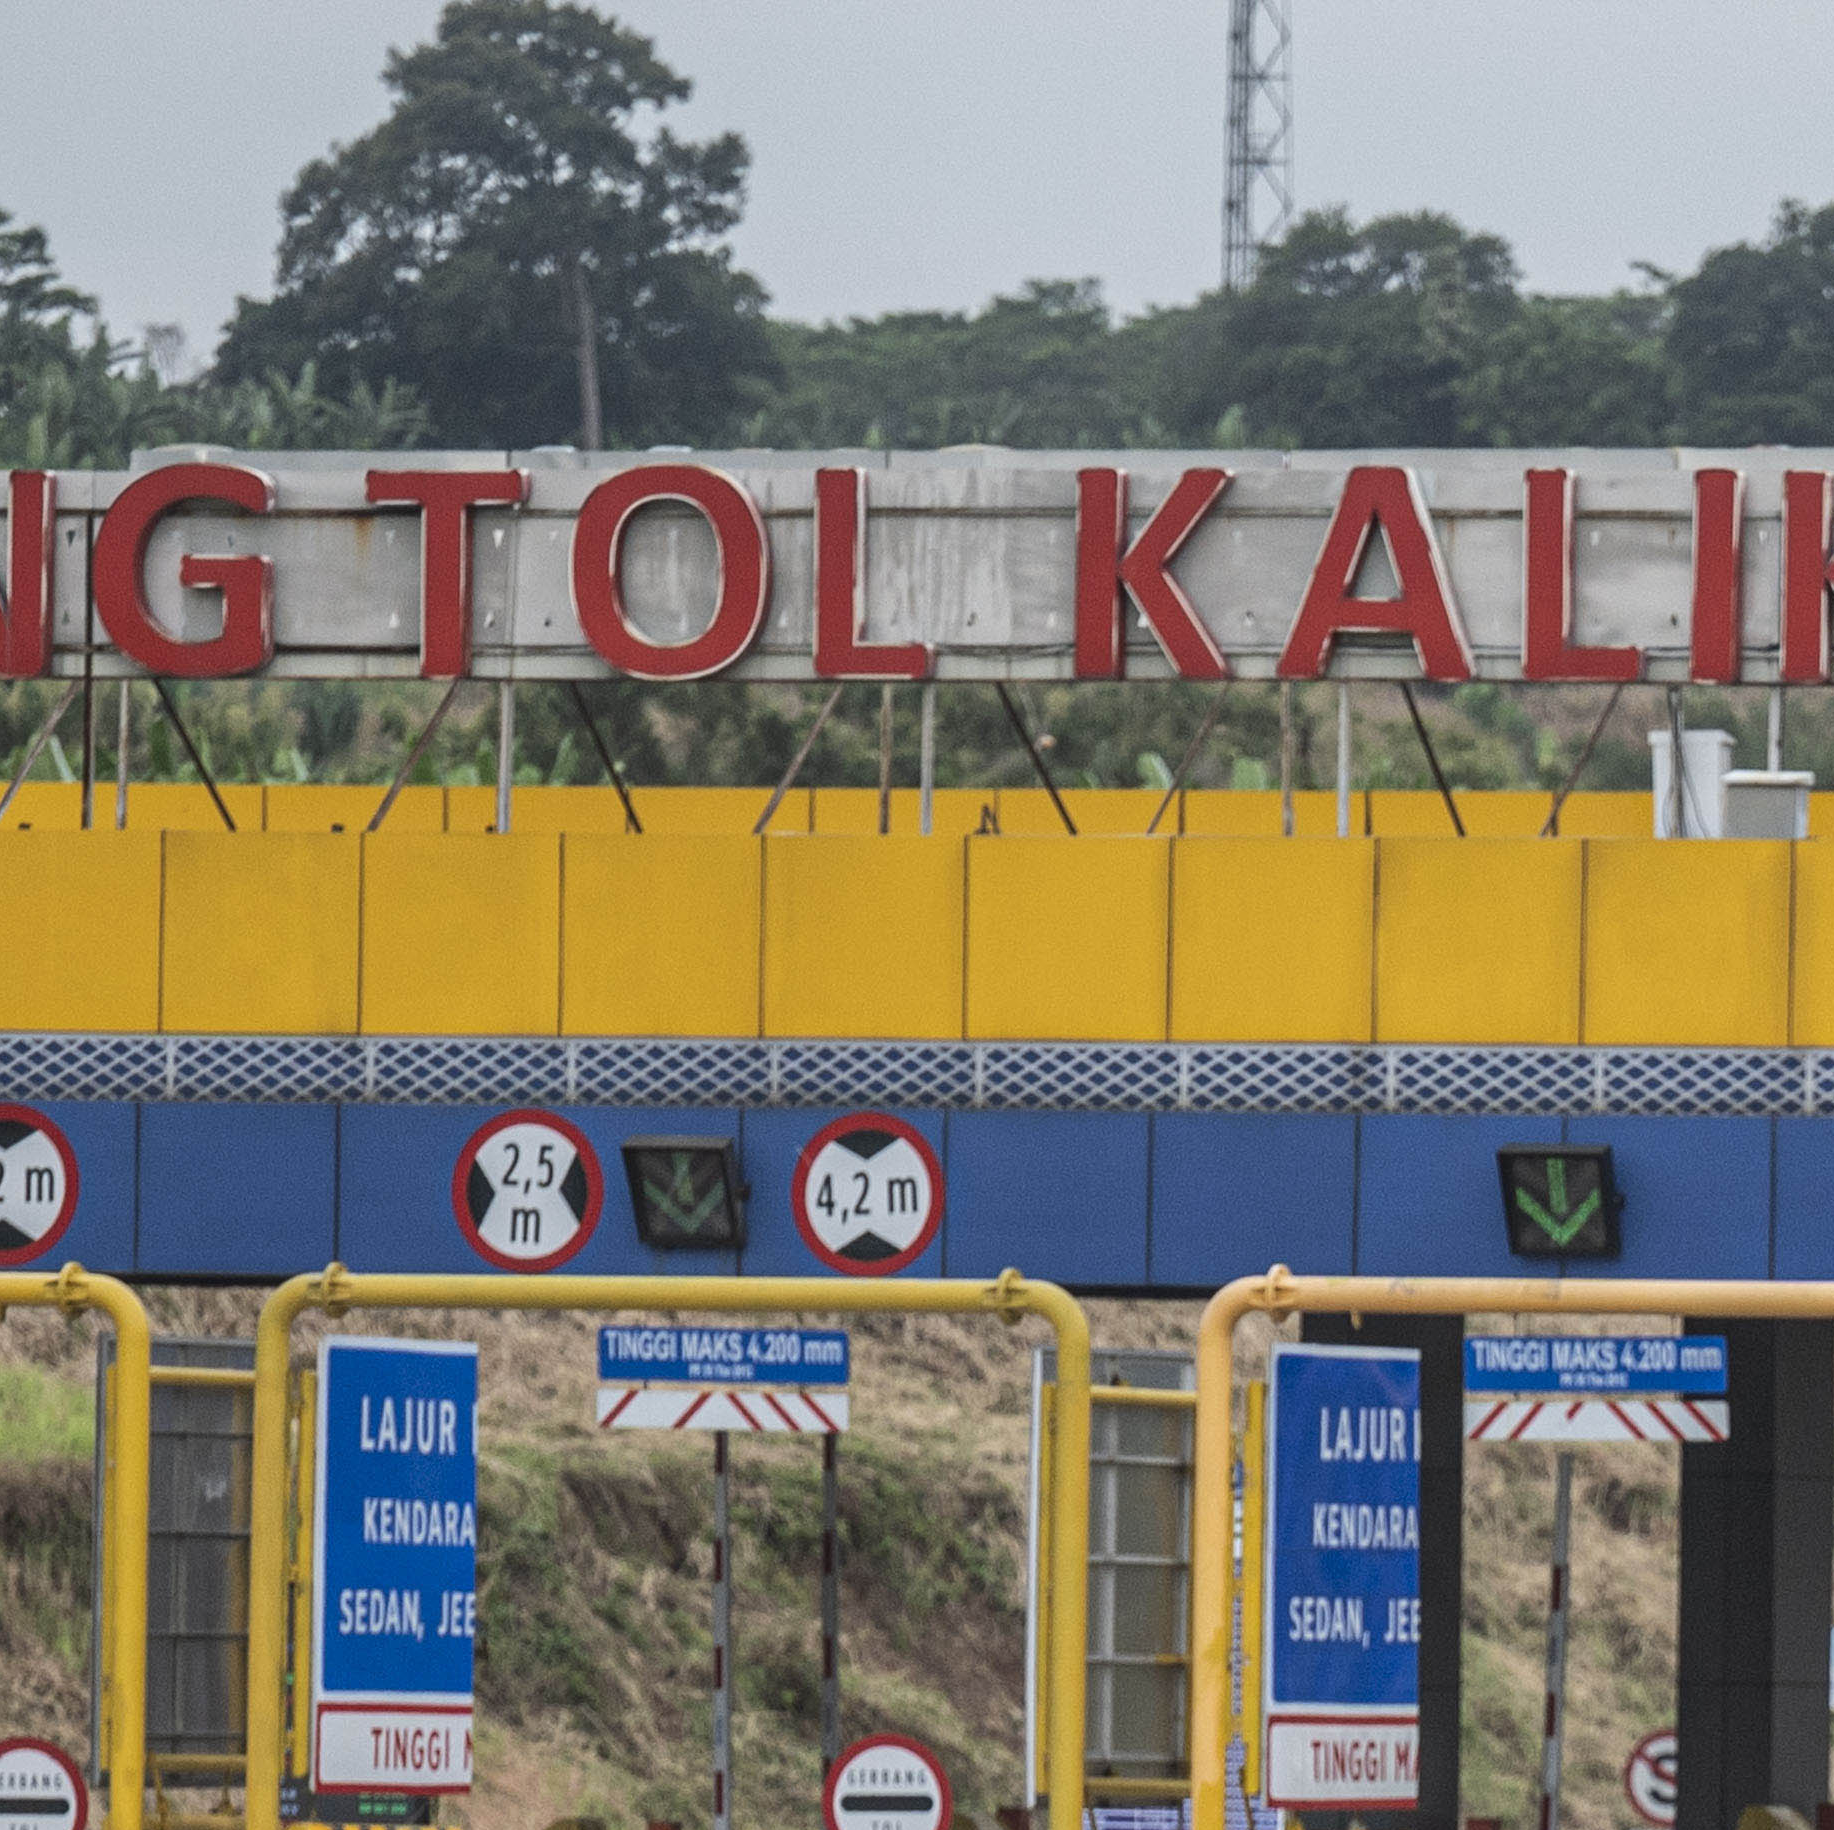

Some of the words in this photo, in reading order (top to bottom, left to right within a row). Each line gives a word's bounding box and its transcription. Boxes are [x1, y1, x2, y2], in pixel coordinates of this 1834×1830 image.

[367, 463, 936, 680] TOL
[24, 1165, 56, 1203] m
[501, 1142, 556, 1196] 2,5
[815, 1172, 871, 1223] 4,2
[886, 1175, 919, 1215] m
[510, 1205, 542, 1244] m
[605, 1329, 678, 1361] TINGGI
[681, 1331, 741, 1362] MAKS
[746, 1333, 801, 1364] 4.200
[803, 1339, 844, 1365] mm
[1471, 1339, 1548, 1371] TINGGI
[1551, 1340, 1617, 1371] MAKS
[1620, 1341, 1677, 1371] 4.200
[1680, 1346, 1723, 1371] mm
[360, 1396, 457, 1456] LAJUR
[1319, 1406, 1408, 1464] LAJUR
[339, 1589, 427, 1643] SEDAN,
[1288, 1598, 1371, 1650] SEDAN,
[370, 1726, 451, 1773] TINGGI
[1310, 1739, 1389, 1785] TINGGI
[846, 1768, 928, 1786] GERBANG
